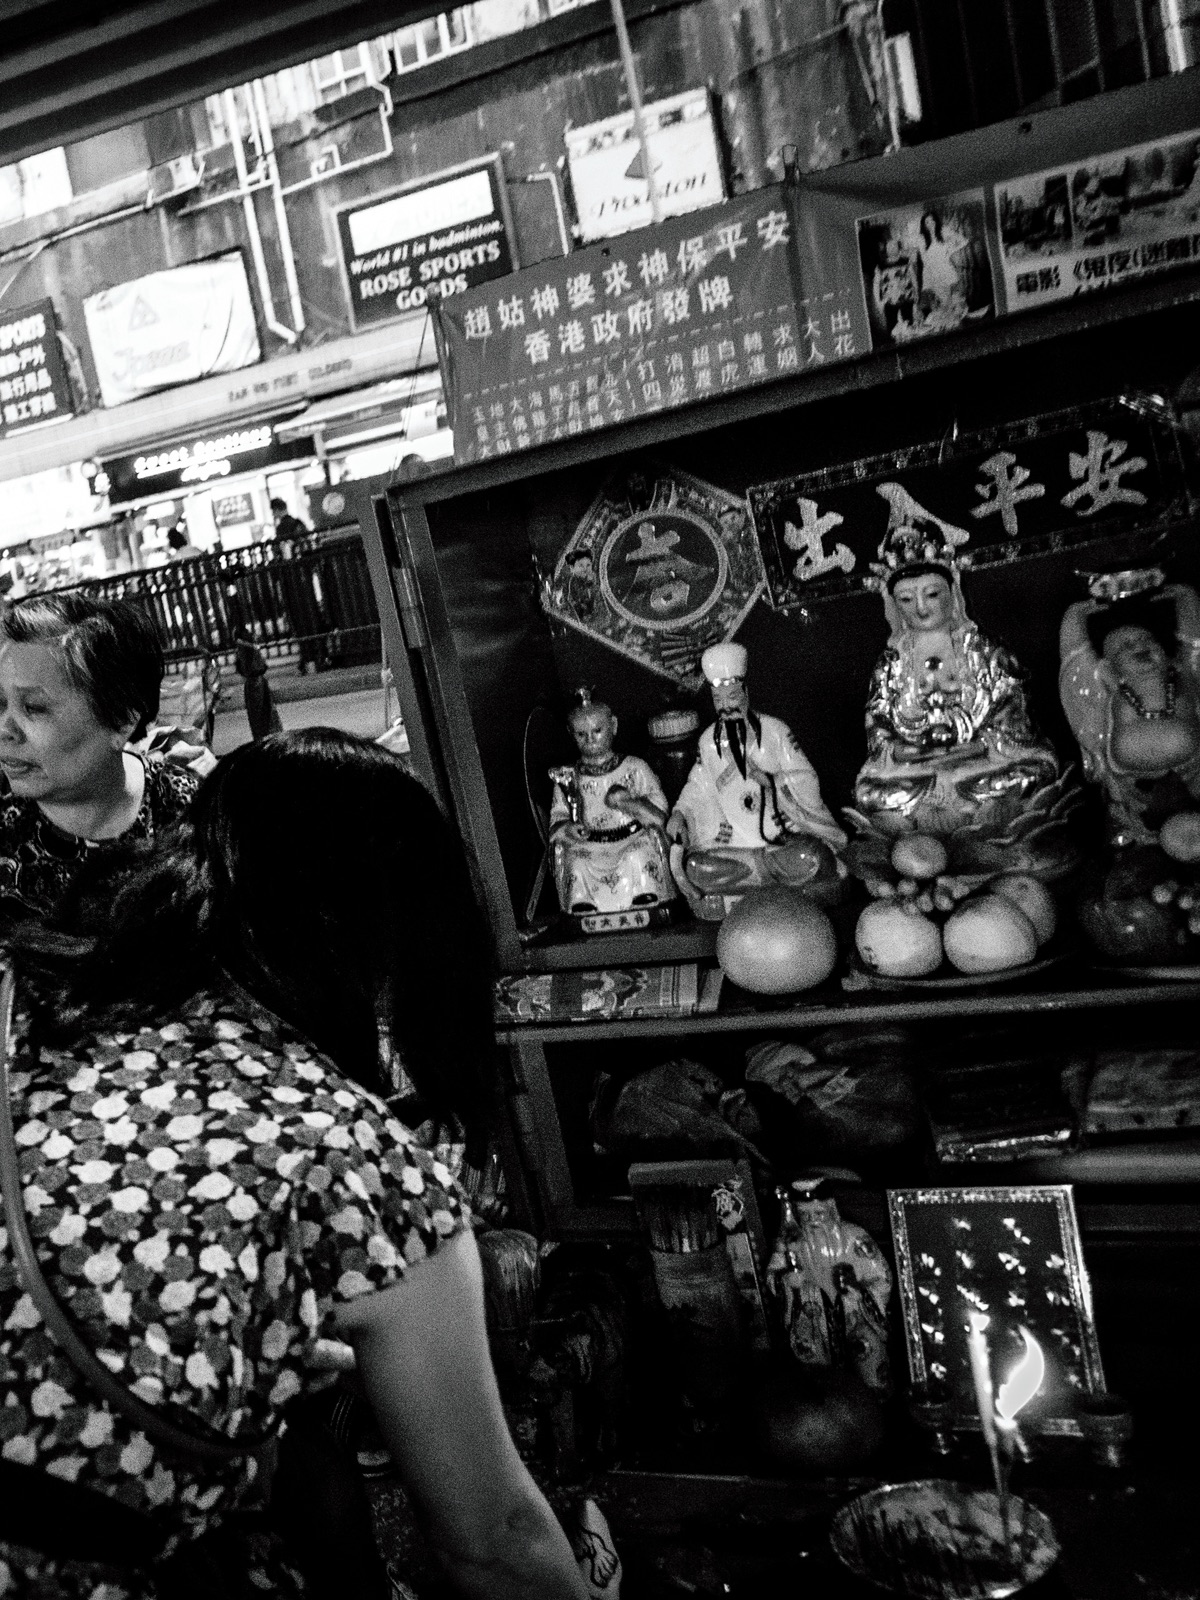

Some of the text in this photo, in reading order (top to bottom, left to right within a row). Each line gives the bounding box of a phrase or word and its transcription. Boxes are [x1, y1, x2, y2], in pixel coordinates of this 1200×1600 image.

[350, 250, 390, 275] World
[412, 241, 427, 257] in
[360, 240, 500, 299] ROSE SPORTS
[464, 210, 790, 340] 趙姑神婆求神保平安
[396, 273, 468, 310] GODS
[524, 275, 733, 365] 香港政府發牌
